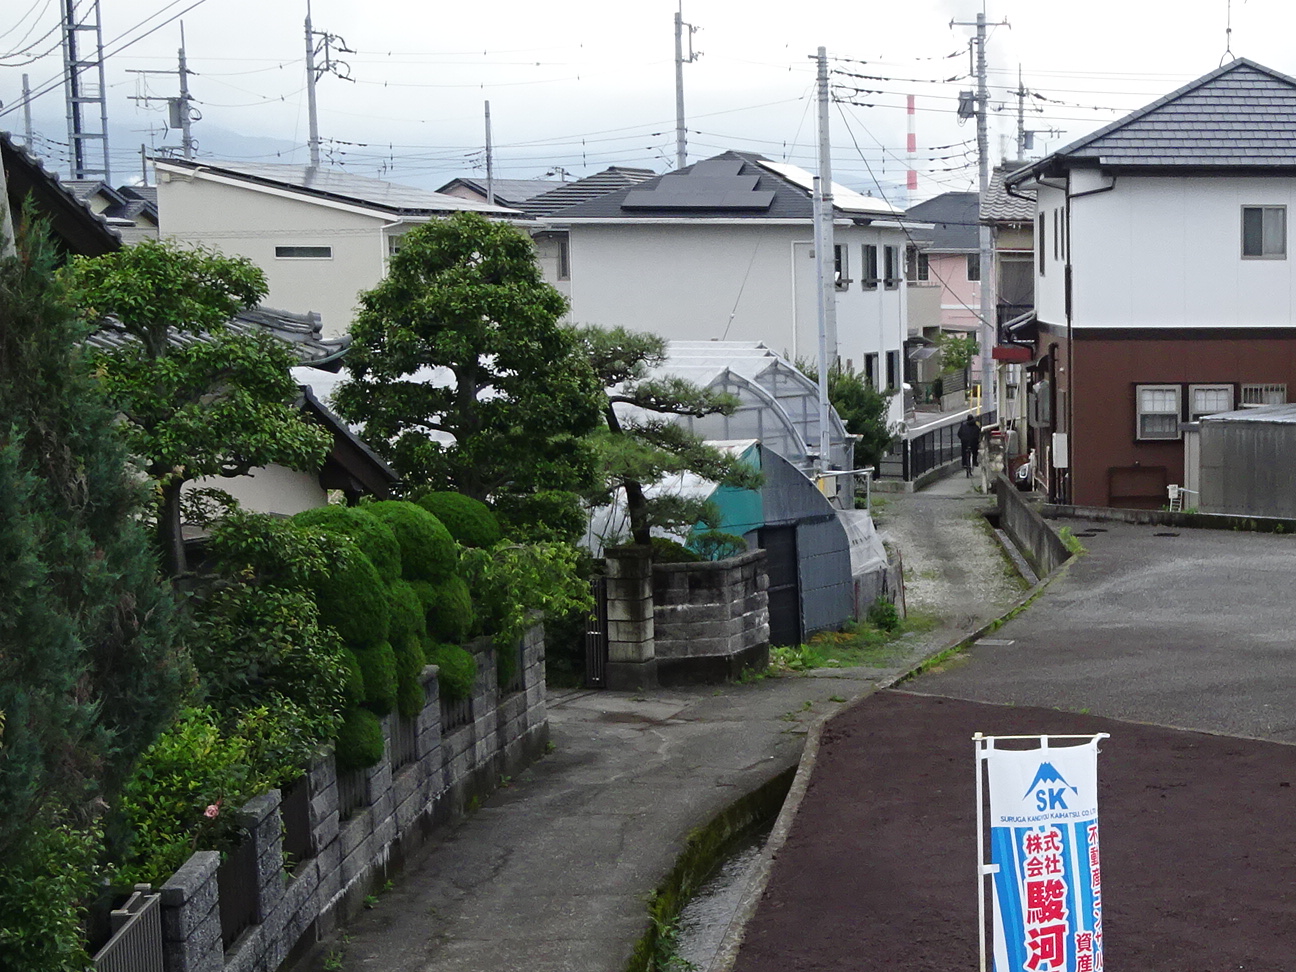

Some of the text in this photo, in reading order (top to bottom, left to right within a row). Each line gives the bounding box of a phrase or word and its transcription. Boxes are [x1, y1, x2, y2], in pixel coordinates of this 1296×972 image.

[1036, 788, 1068, 812] SK
[1000, 815, 1027, 823] SURUGA
[1025, 831, 1061, 854] 株式
[1026, 857, 1062, 877] 会社
